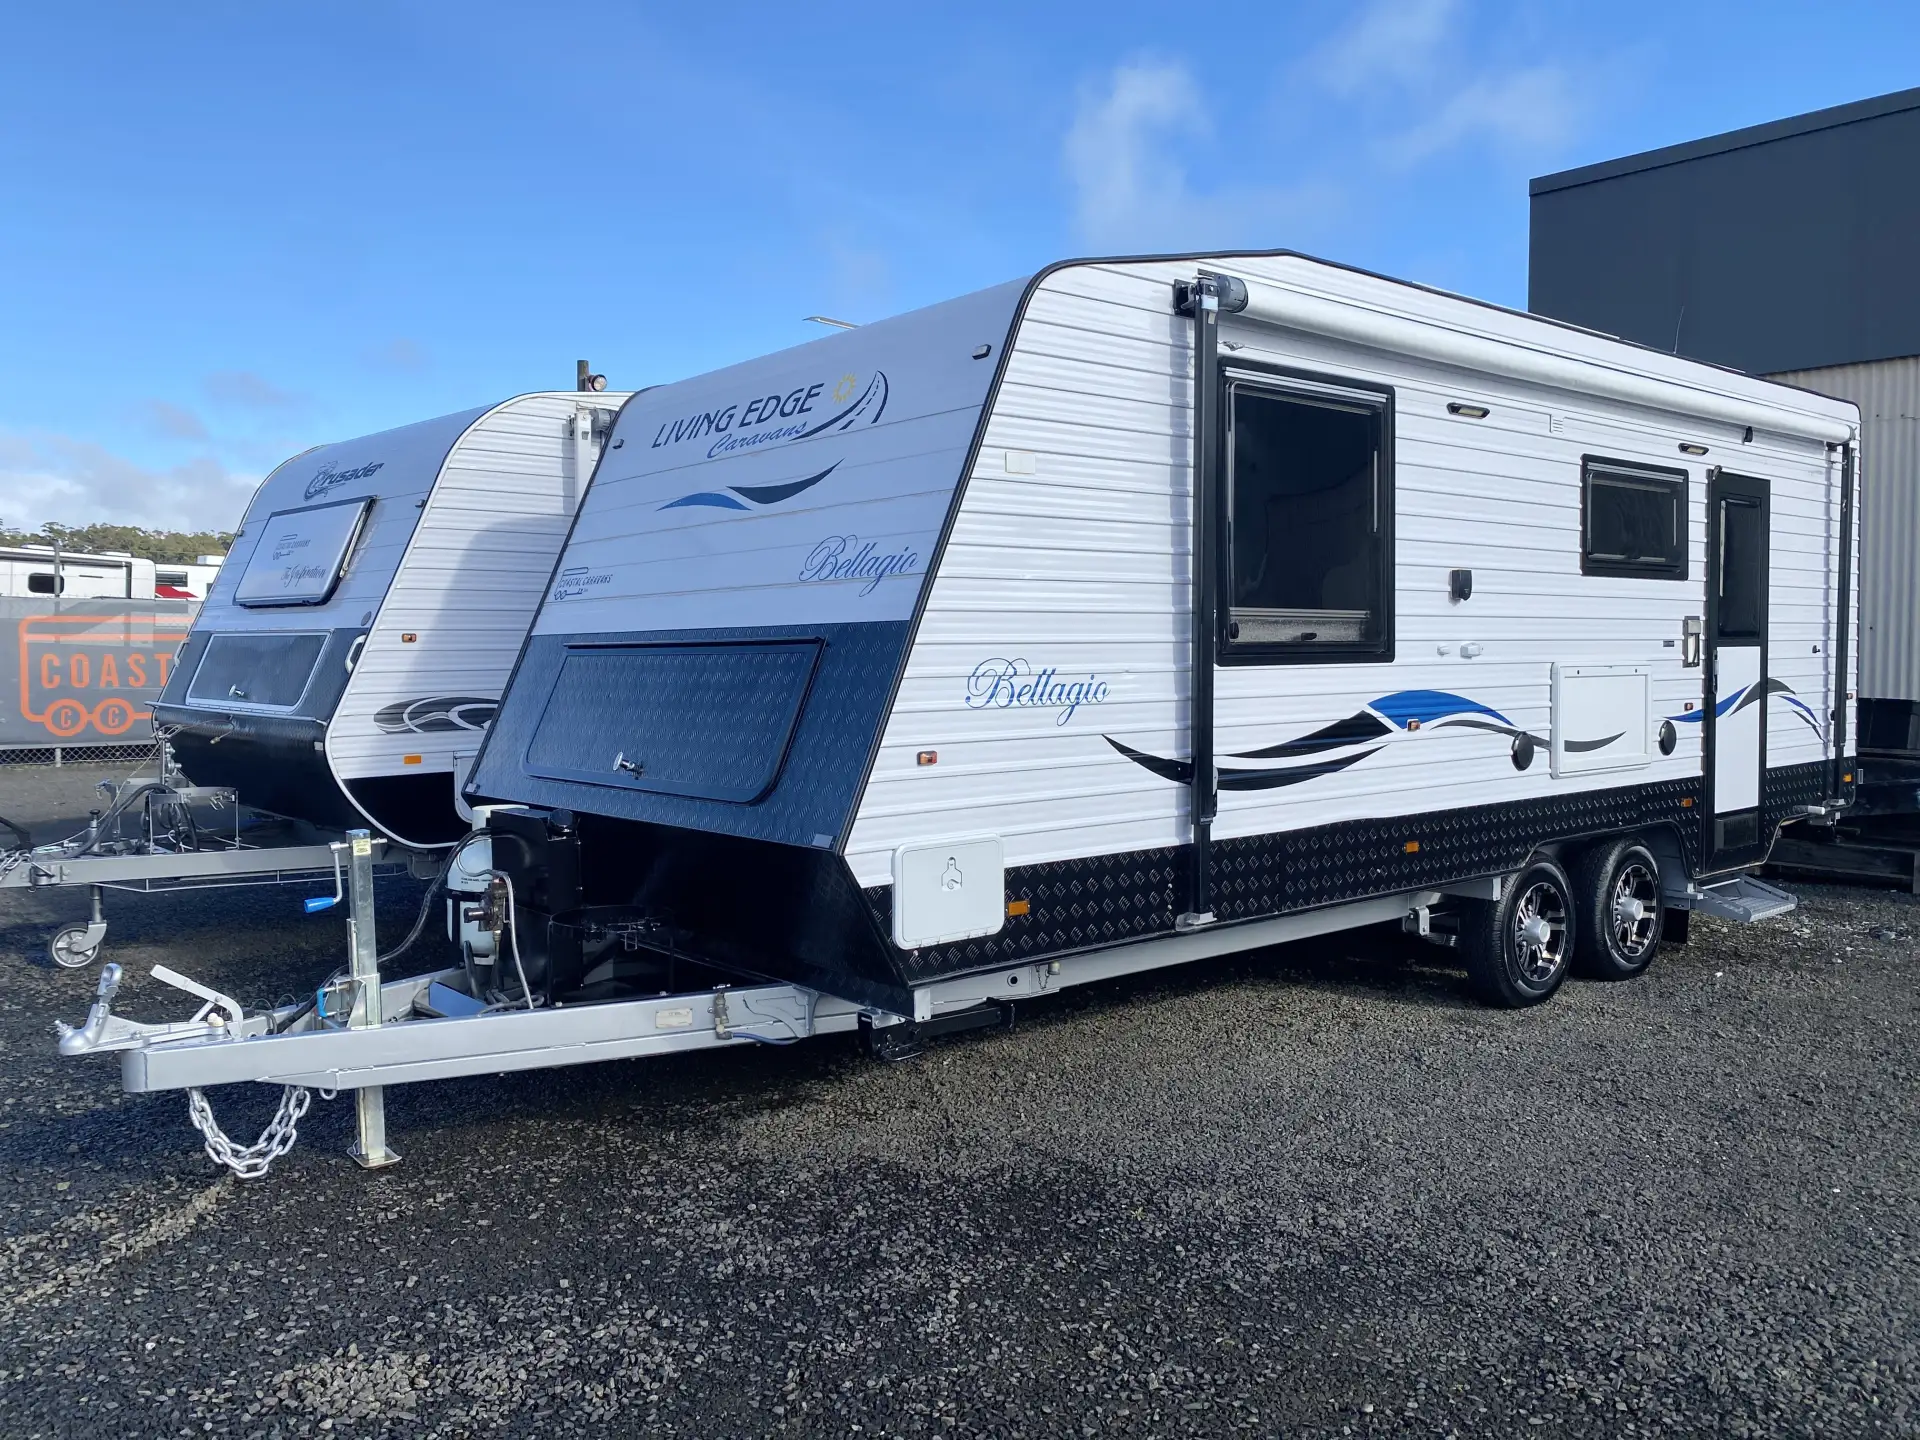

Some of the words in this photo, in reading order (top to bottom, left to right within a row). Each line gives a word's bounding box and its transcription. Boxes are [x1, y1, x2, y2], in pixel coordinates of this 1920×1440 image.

[651, 405, 738, 449] LIVING
[738, 382, 825, 428] EDGE
[706, 421, 808, 459] Caravans
[303, 461, 385, 502] Crusader
[798, 534, 919, 598] Bellagio
[40, 653, 173, 689] COAST
[965, 657, 1111, 726] Bellagio
